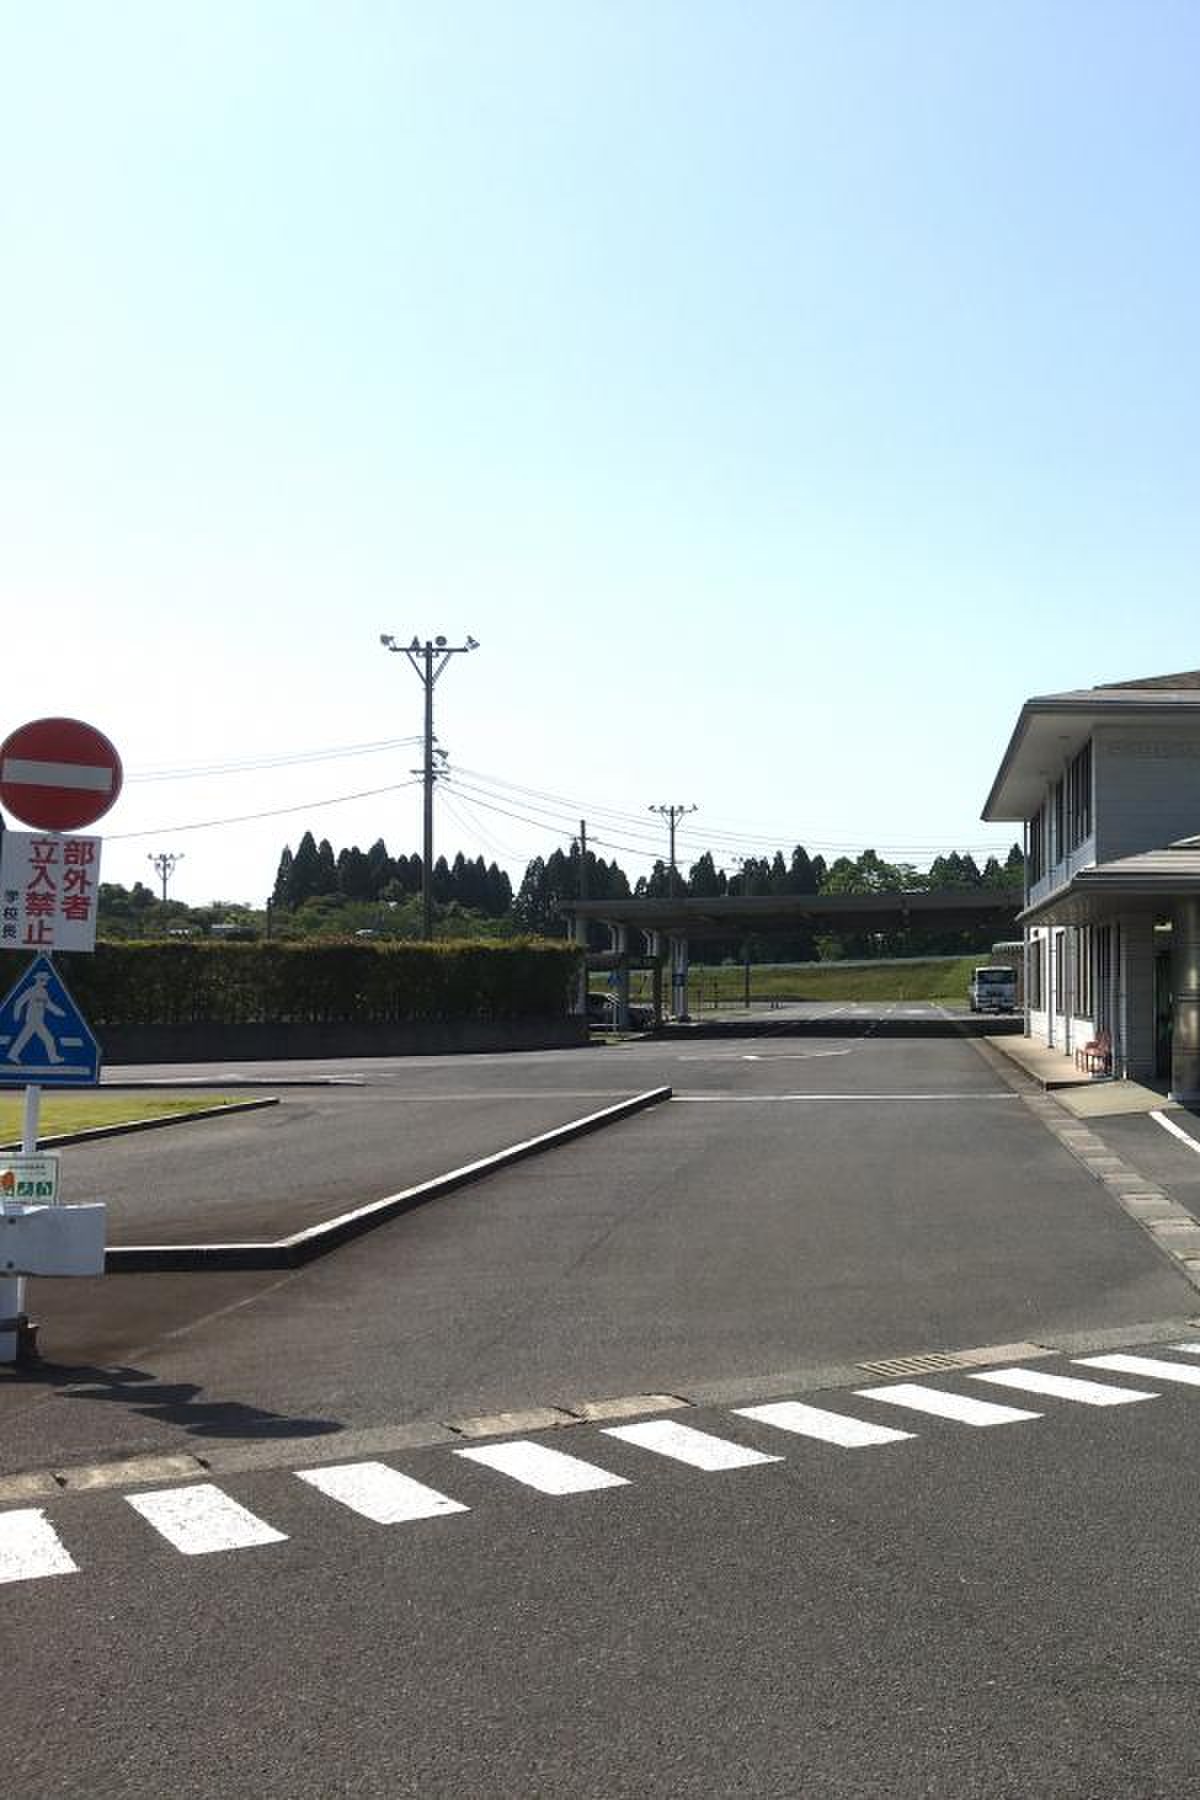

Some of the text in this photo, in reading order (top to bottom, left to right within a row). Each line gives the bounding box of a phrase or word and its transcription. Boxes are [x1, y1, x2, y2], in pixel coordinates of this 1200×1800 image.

[22, 838, 59, 944] 立入禁止
[61, 839, 95, 921] 部外者
